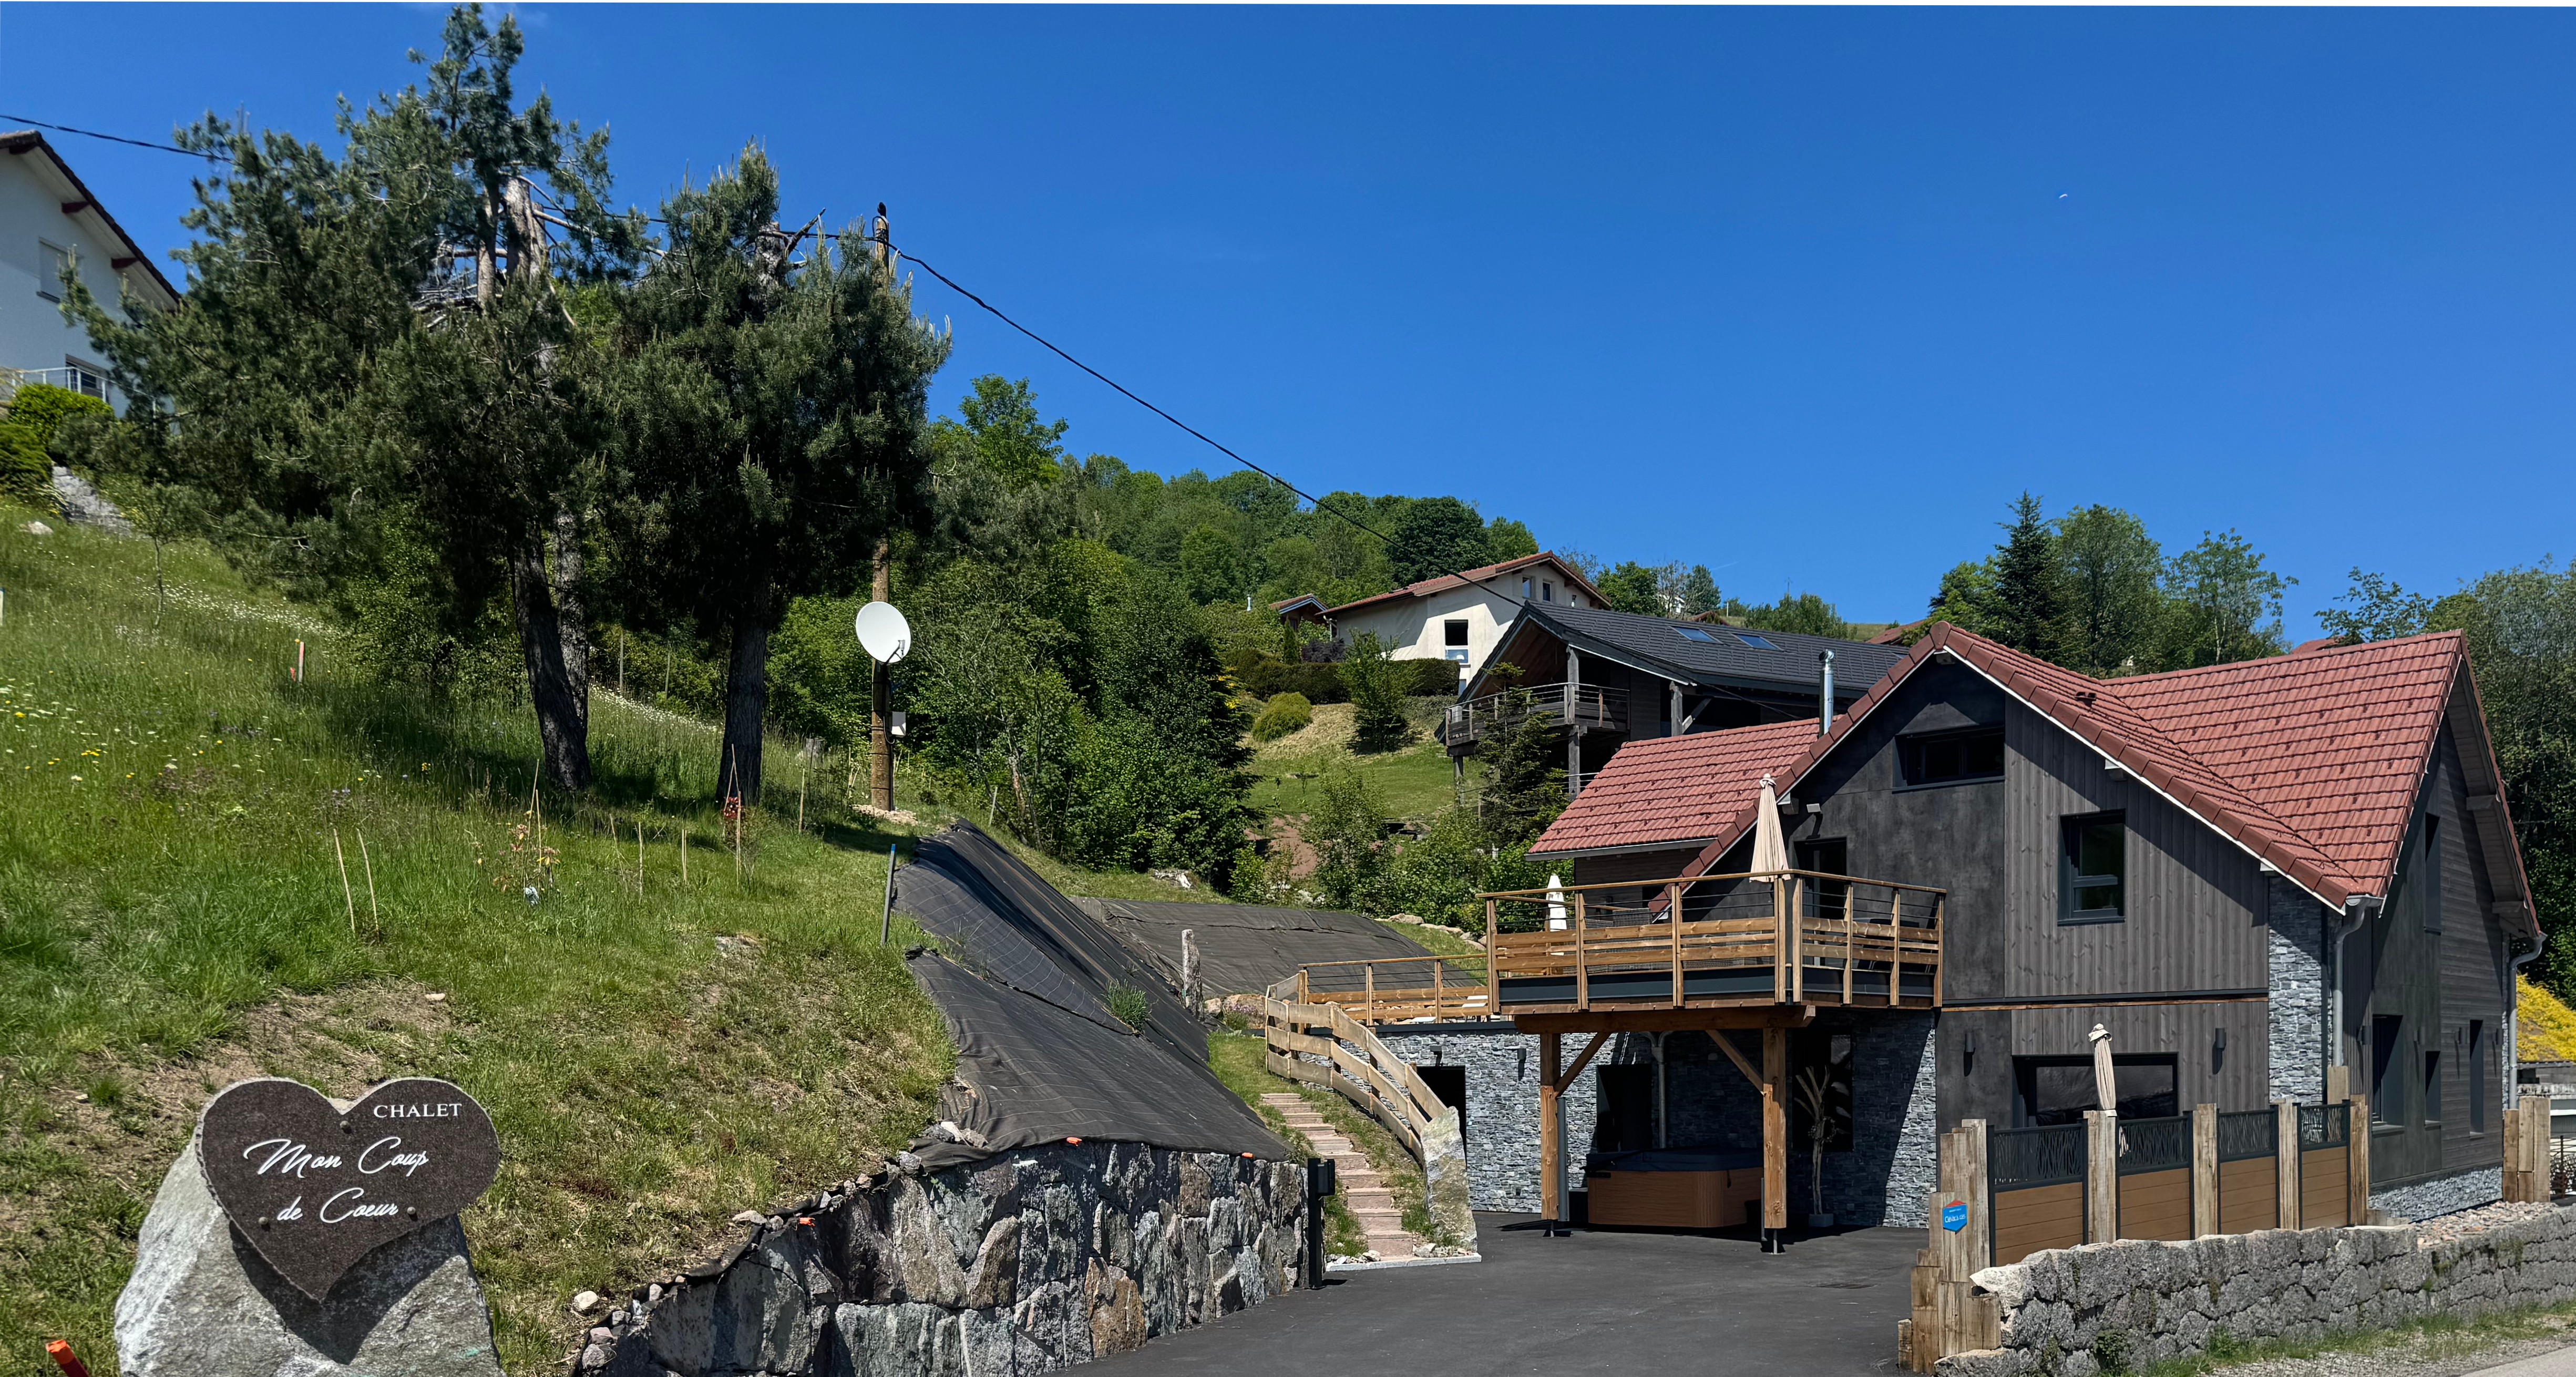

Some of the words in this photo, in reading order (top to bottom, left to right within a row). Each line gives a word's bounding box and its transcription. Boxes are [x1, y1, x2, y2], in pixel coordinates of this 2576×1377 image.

[373, 1103, 462, 1118] CHALET
[243, 1138, 342, 1178] Mon
[358, 1137, 428, 1177] Coup
[277, 1196, 303, 1221] de
[320, 1187, 398, 1224] Coeur
